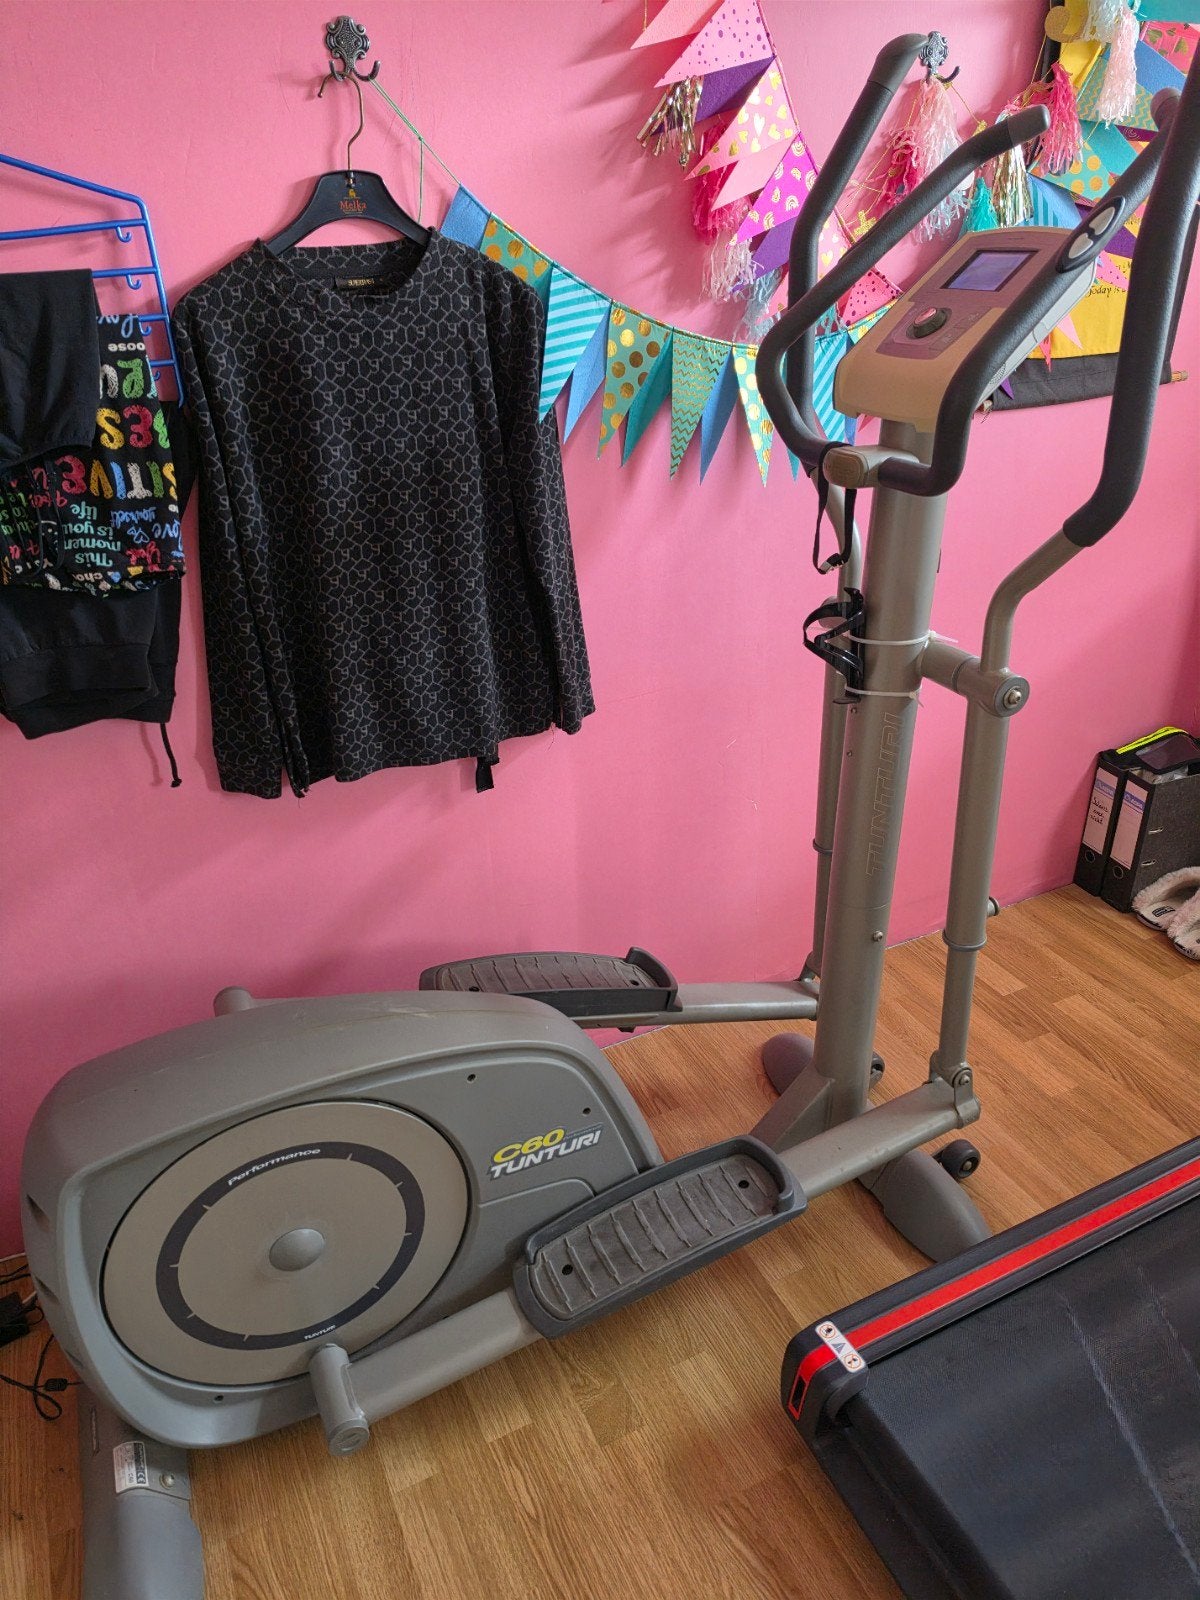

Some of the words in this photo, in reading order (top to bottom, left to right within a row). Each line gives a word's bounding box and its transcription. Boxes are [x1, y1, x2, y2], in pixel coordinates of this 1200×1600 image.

[339, 199, 367, 210] Melka
[70, 501, 98, 520] life
[62, 521, 95, 536] you
[97, 526, 114, 540] is
[64, 538, 121, 552] momen
[75, 552, 114, 568] This
[865, 711, 901, 877] TUNTURI
[493, 1128, 565, 1163] C60
[490, 1130, 602, 1179] TUNTURI
[228, 1148, 321, 1186] Performance
